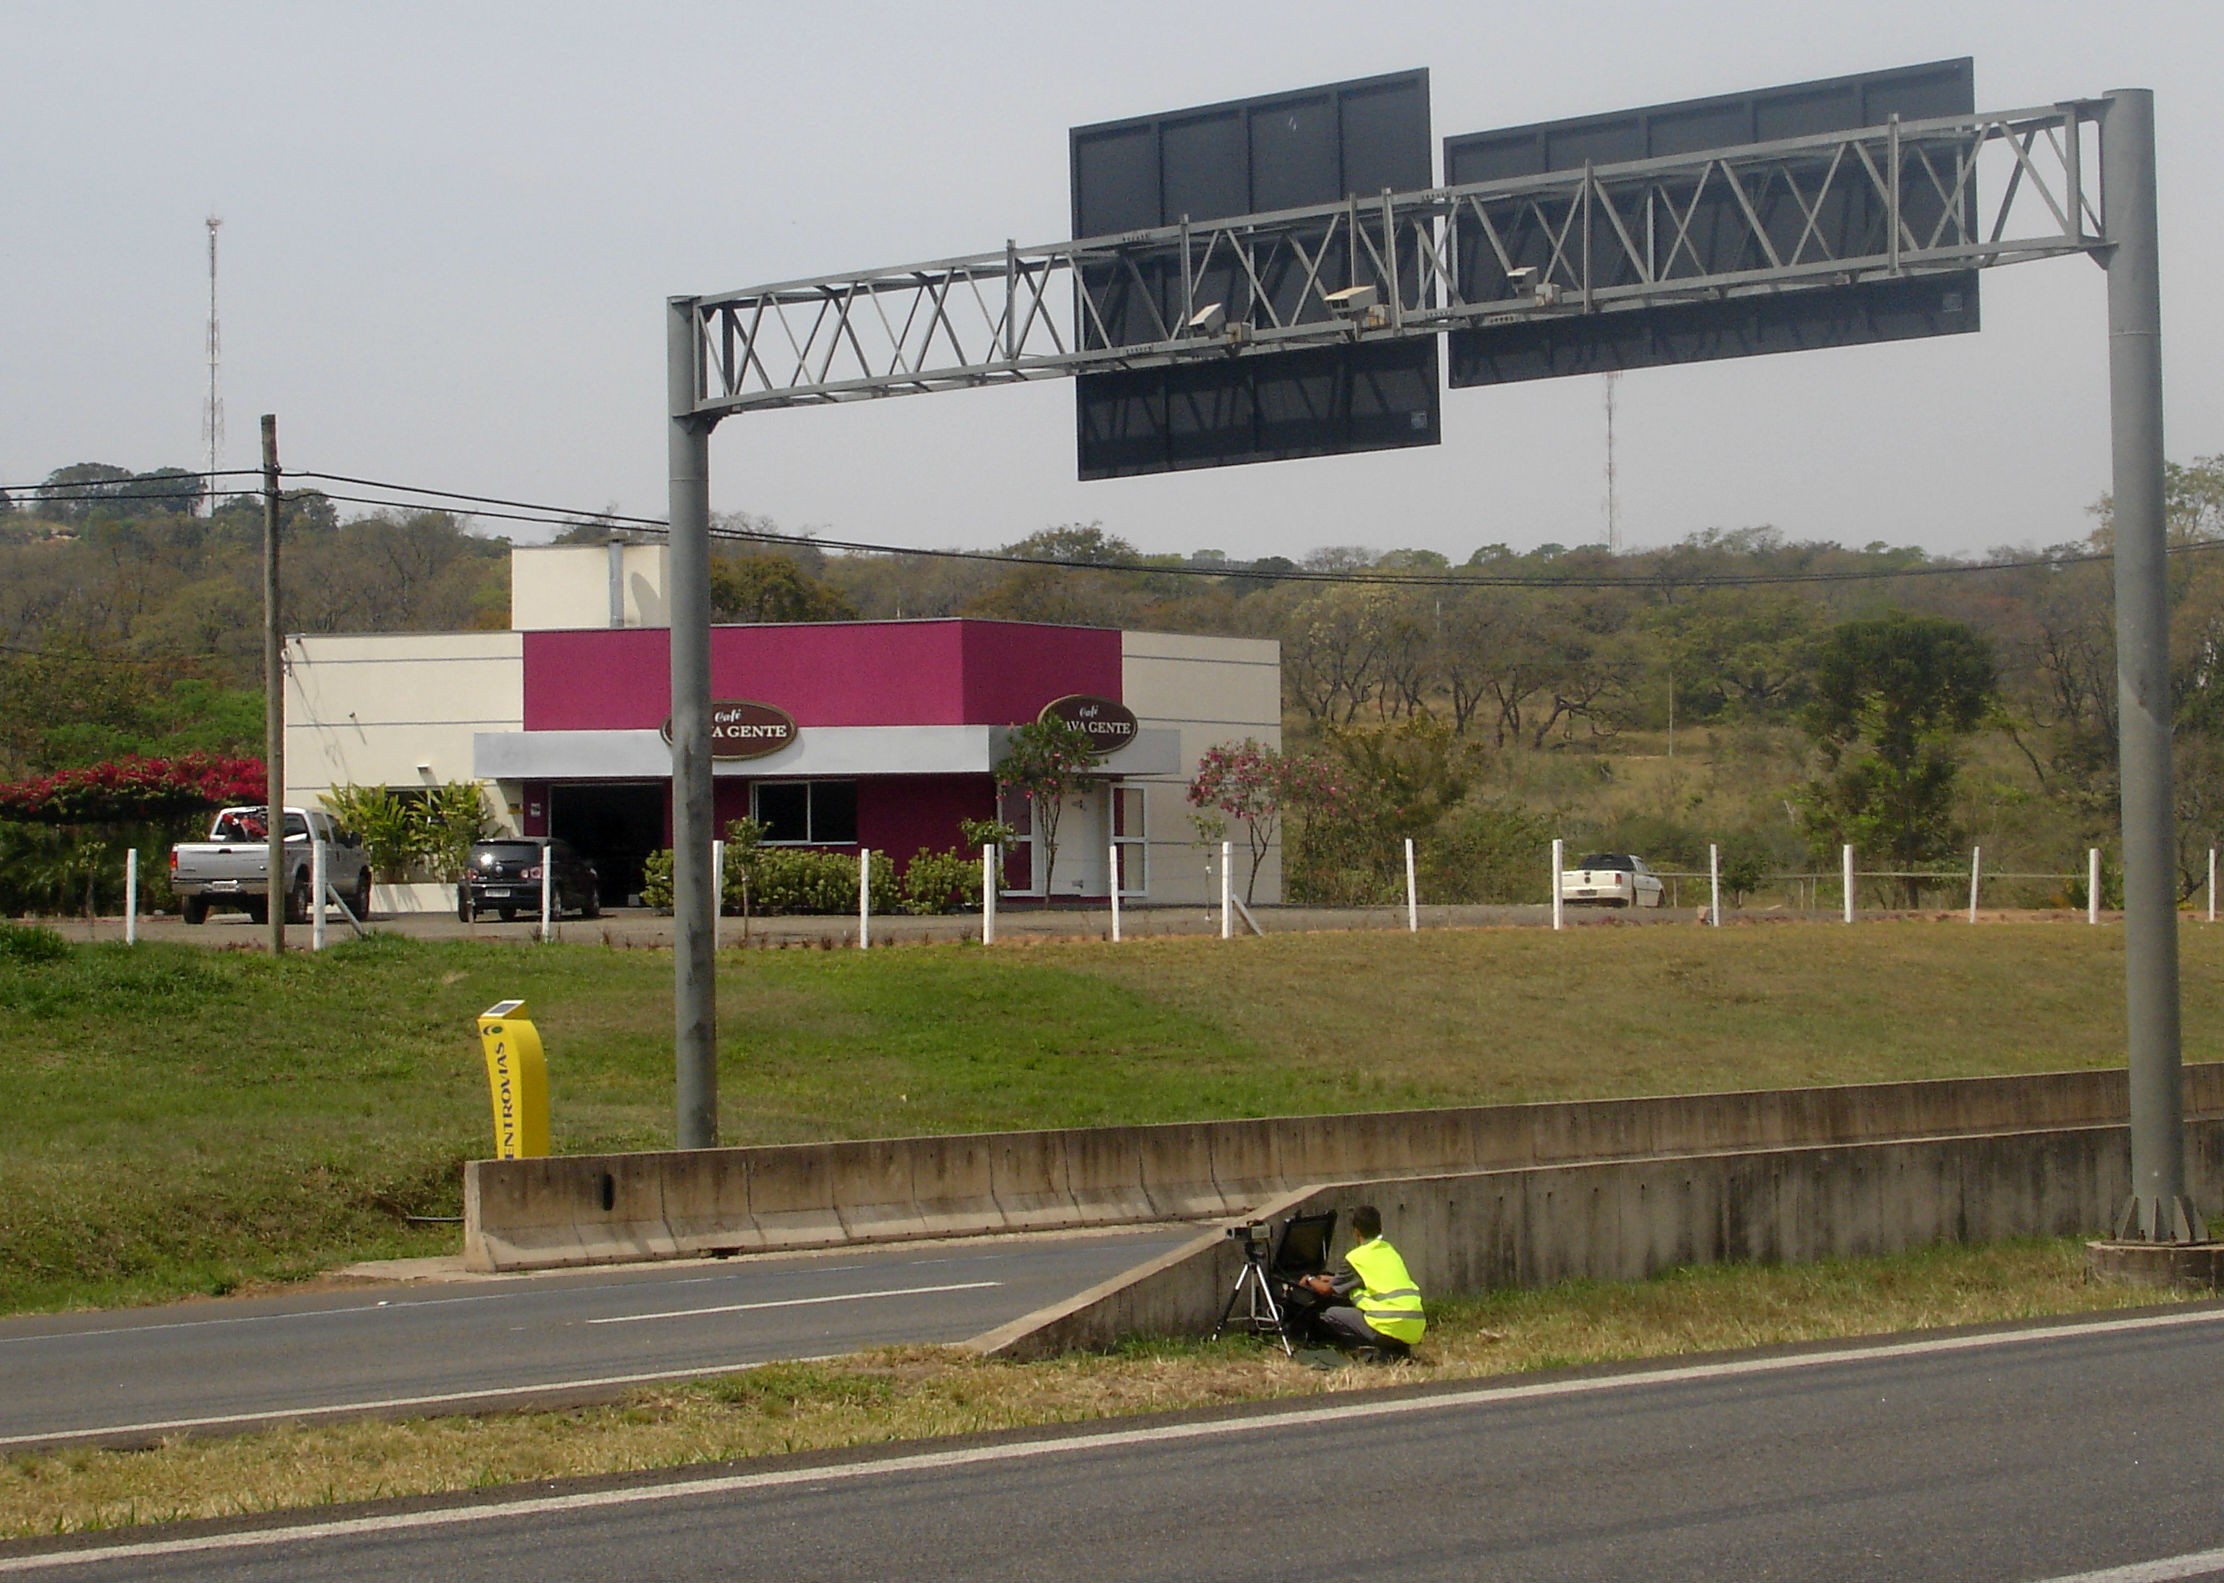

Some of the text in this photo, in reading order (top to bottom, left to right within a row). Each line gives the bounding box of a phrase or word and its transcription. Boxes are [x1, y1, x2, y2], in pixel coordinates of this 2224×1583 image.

[714, 708, 742, 722] Café
[1079, 705, 1098, 718] Café
[726, 725, 787, 738] GENTE
[1088, 721, 1131, 734] GENTE
[495, 1041, 515, 1160] ENTROVIAS
